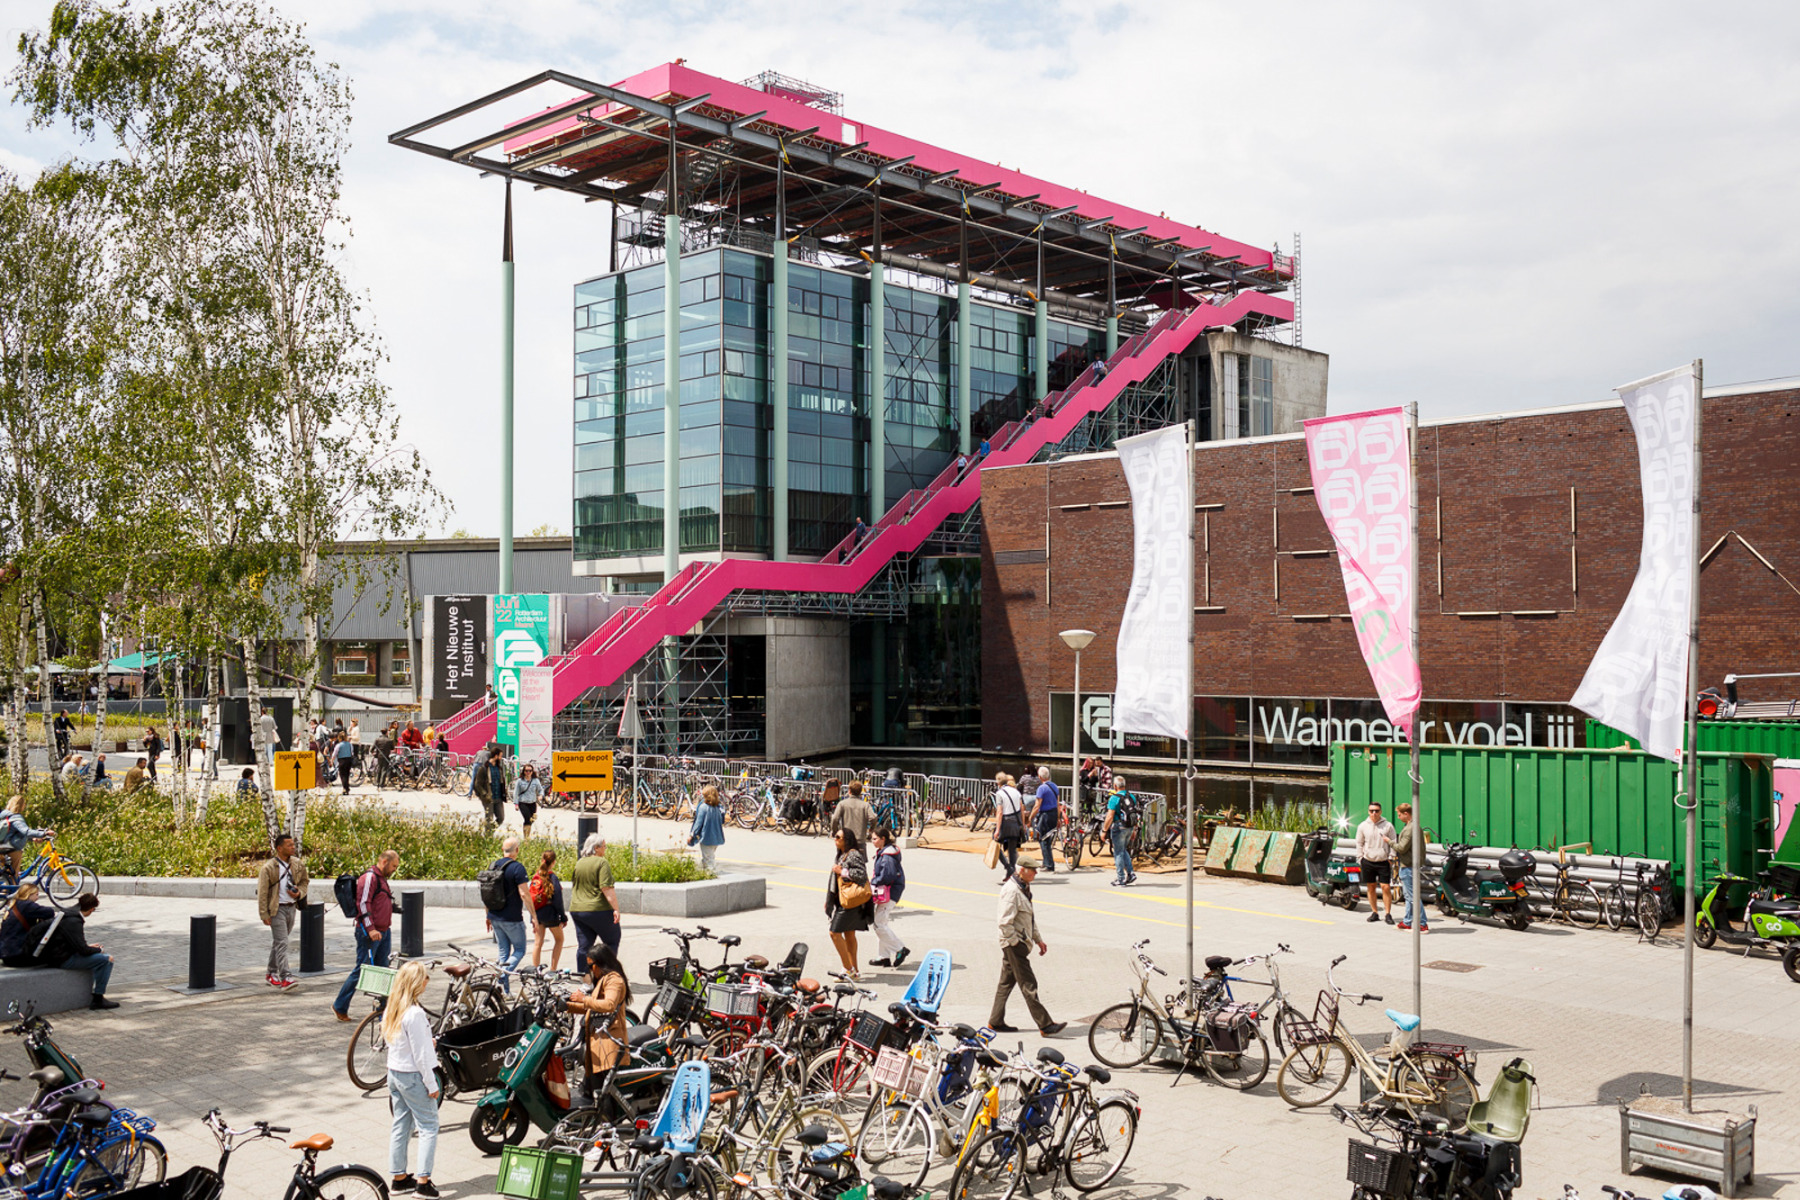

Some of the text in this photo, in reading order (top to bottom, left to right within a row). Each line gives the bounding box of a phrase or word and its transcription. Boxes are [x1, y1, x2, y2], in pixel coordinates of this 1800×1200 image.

[446, 606, 459, 660] Nieuwe
[461, 619, 474, 677] Instituut
[446, 664, 458, 690] Het
[1259, 706, 1436, 747] Wanneer
[1443, 712, 1532, 747] voel
[278, 752, 313, 761] Ingang depot
[557, 754, 609, 763] Ingang depot
[1766, 922, 1782, 932] GO
